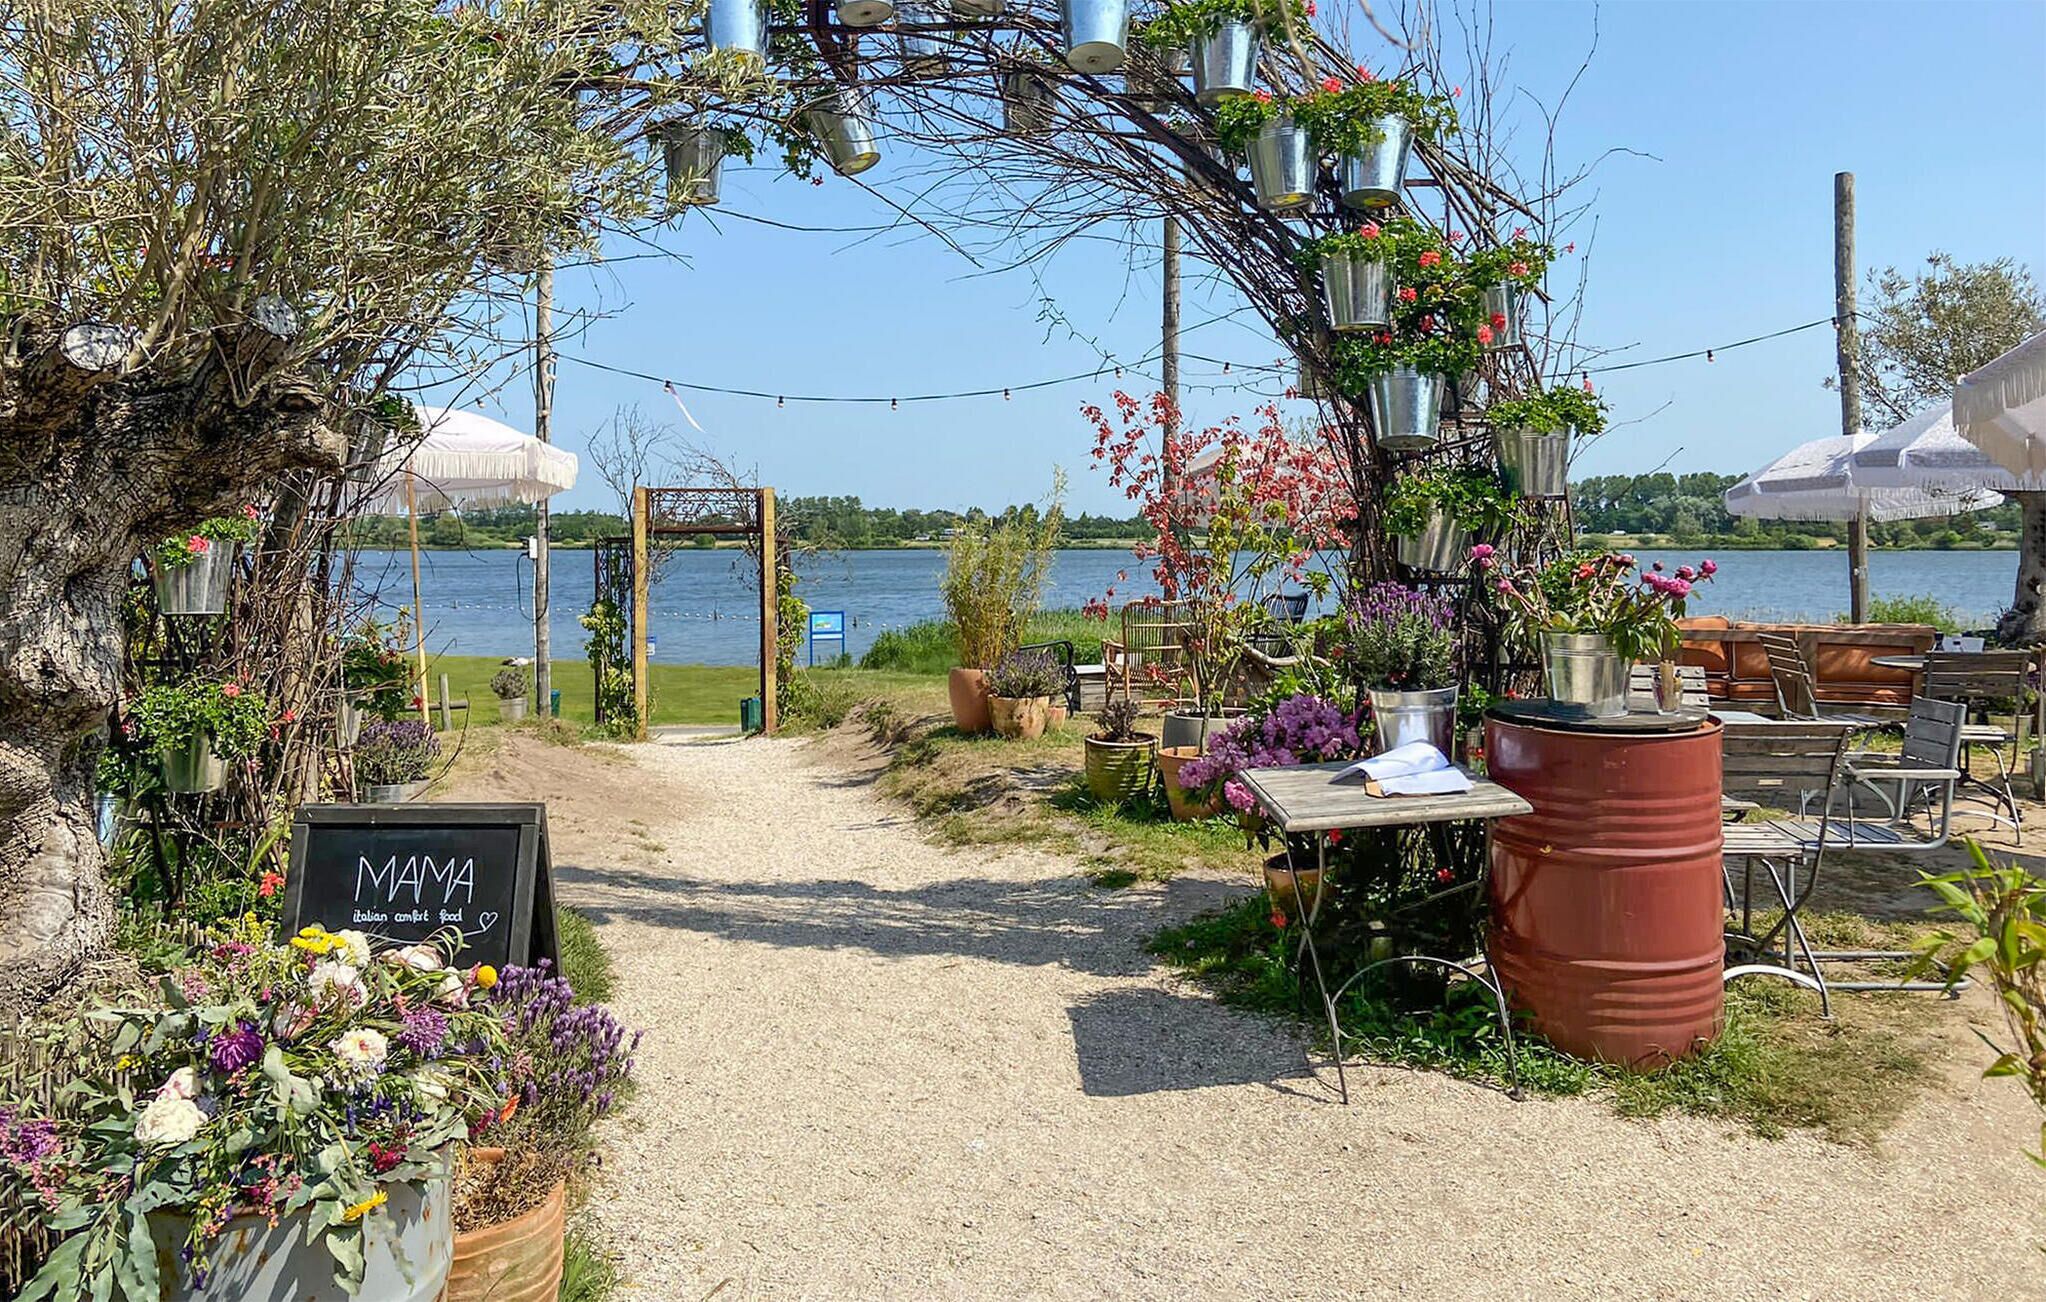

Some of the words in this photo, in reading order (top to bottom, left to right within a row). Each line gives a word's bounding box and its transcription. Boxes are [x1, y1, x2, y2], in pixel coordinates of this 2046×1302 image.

[354, 855, 474, 904] MAMA
[353, 905, 388, 923] italian
[439, 907, 463, 924] food
